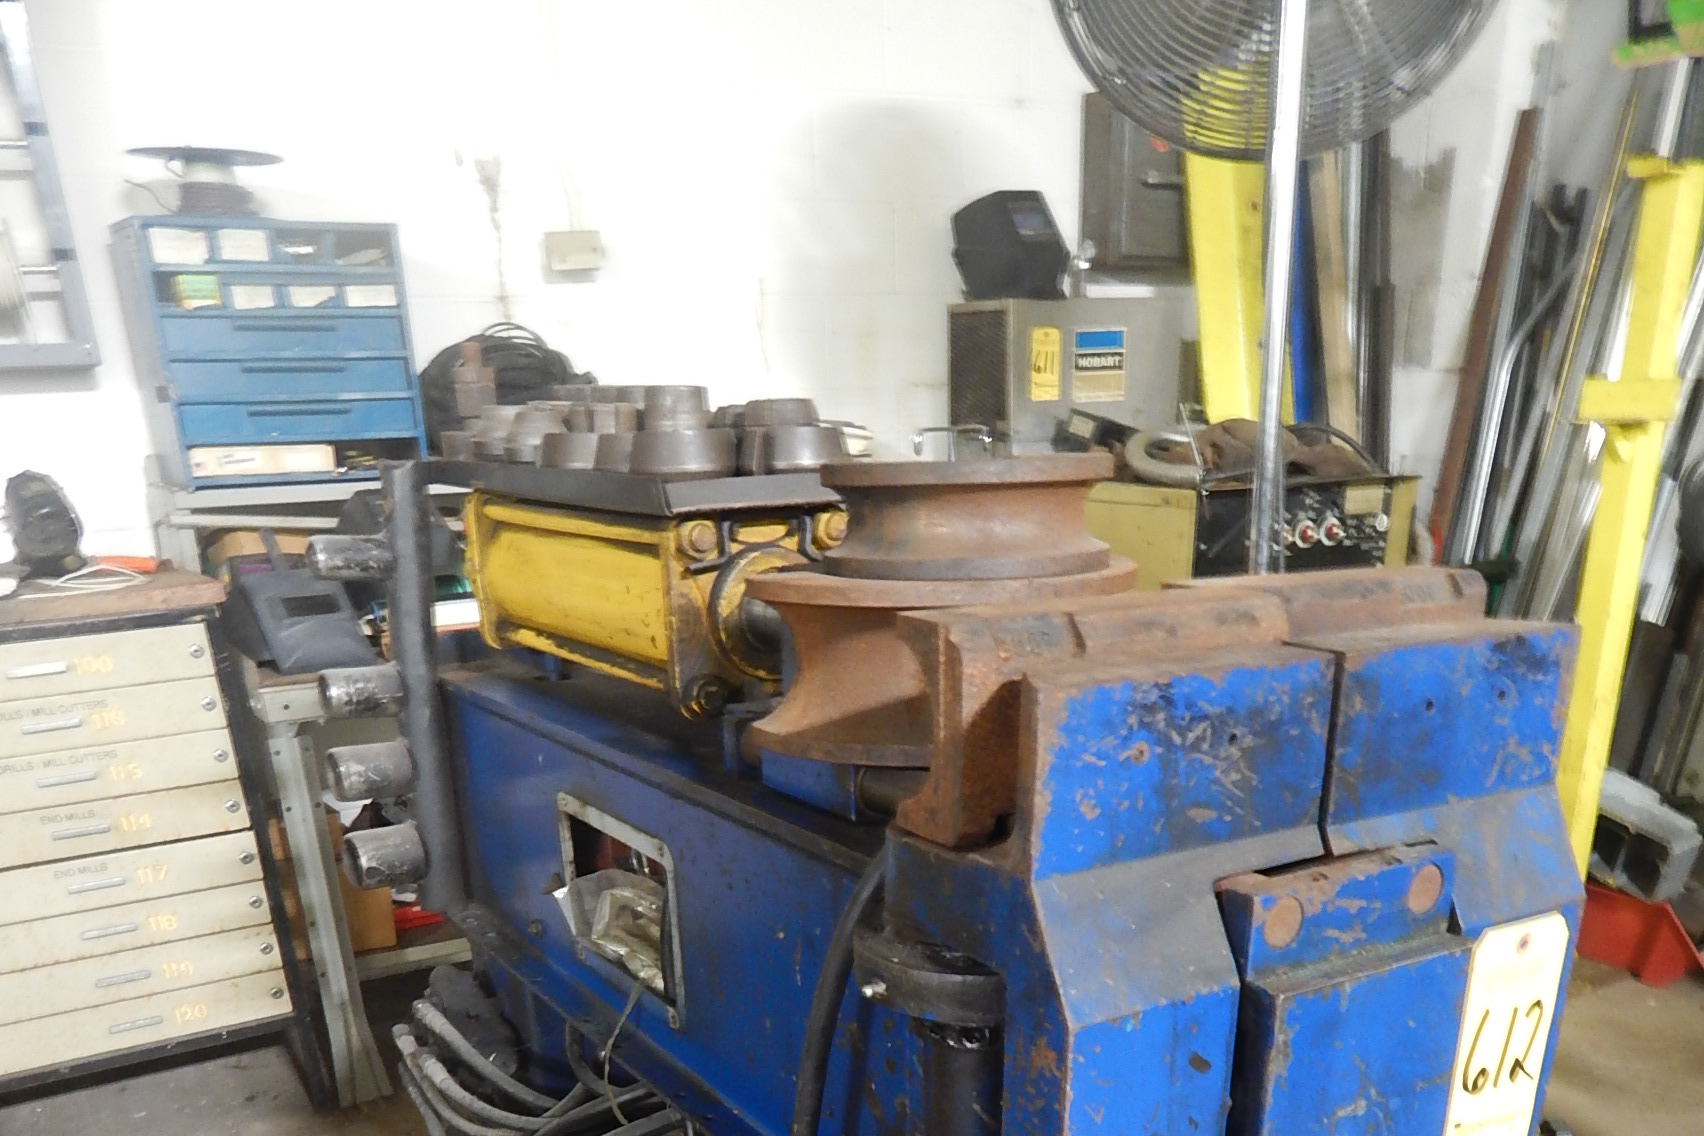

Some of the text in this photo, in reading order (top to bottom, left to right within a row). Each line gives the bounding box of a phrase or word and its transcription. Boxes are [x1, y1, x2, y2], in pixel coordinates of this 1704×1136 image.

[1077, 355, 1123, 368] HOBART
[0, 709, 23, 722] ILLS
[31, 706, 56, 717] MILL
[59, 699, 109, 715] CUTTERS
[42, 757, 67, 770] MILL
[68, 749, 118, 765] CUTTERS
[108, 762, 144, 782] 115
[40, 809, 96, 825] END MILLS
[120, 812, 151, 832] 114
[53, 862, 109, 879] END MILLS
[136, 864, 168, 885] 117
[148, 914, 177, 932] 118
[162, 961, 193, 979] 119
[174, 1003, 208, 1023] 120
[1462, 999, 1544, 1096] 612
